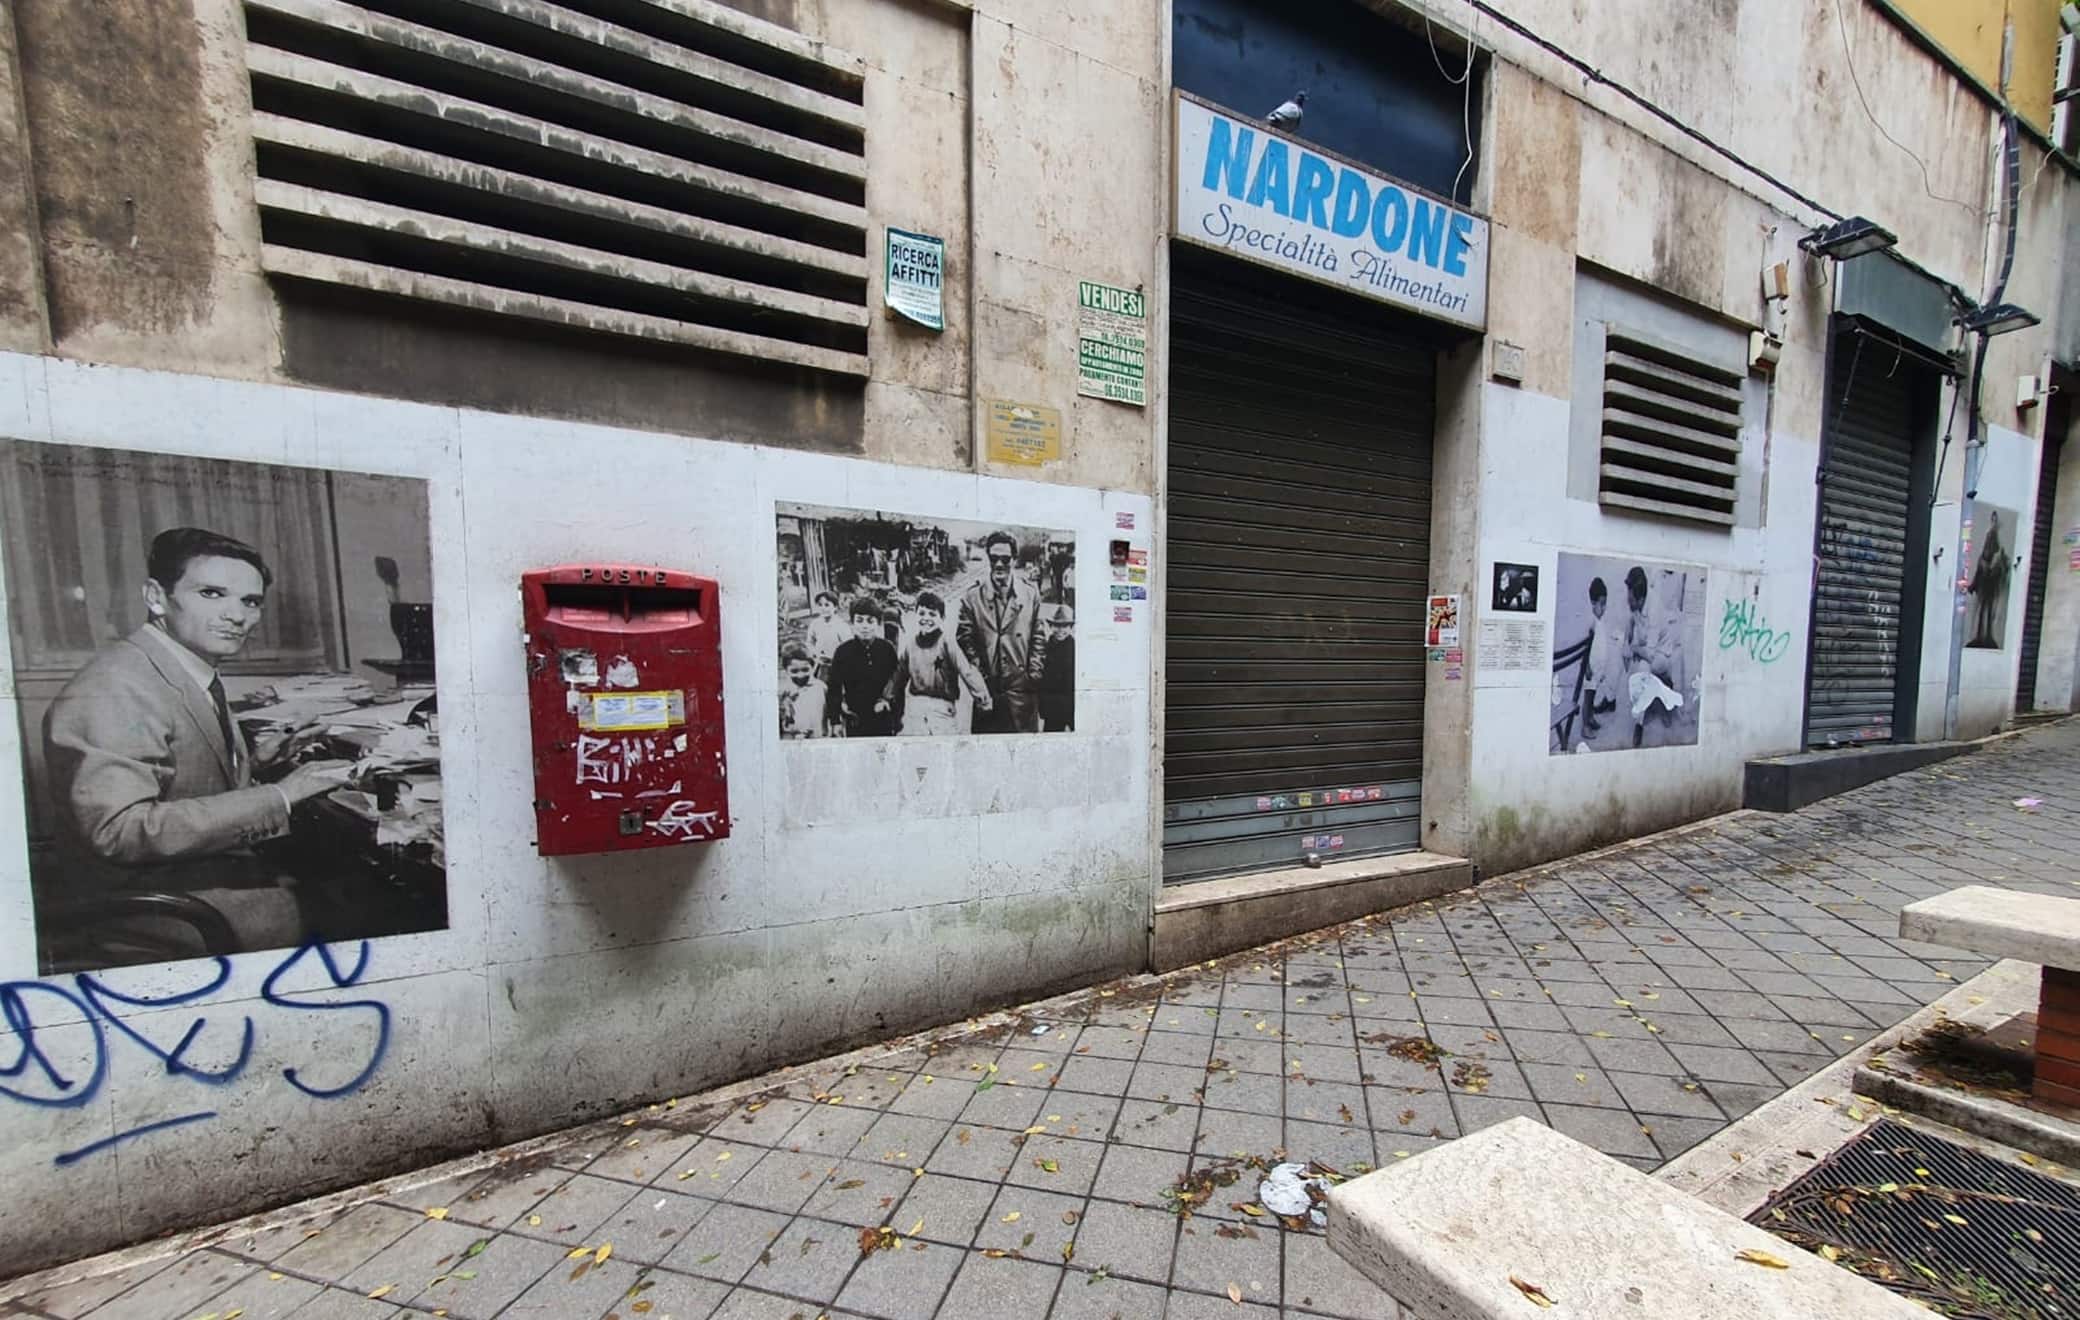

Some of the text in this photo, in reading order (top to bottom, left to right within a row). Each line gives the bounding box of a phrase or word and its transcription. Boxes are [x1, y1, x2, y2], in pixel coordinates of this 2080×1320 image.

[1202, 115, 1472, 277] NARDONE
[891, 243, 939, 270] RICERCA
[1202, 203, 1470, 313] Specialità Alimentari
[891, 262, 940, 288] AFFITTI
[1081, 283, 1143, 317] VENDESI
[1081, 339, 1144, 367] CERCHIAMO
[582, 568, 667, 584] POSTE
